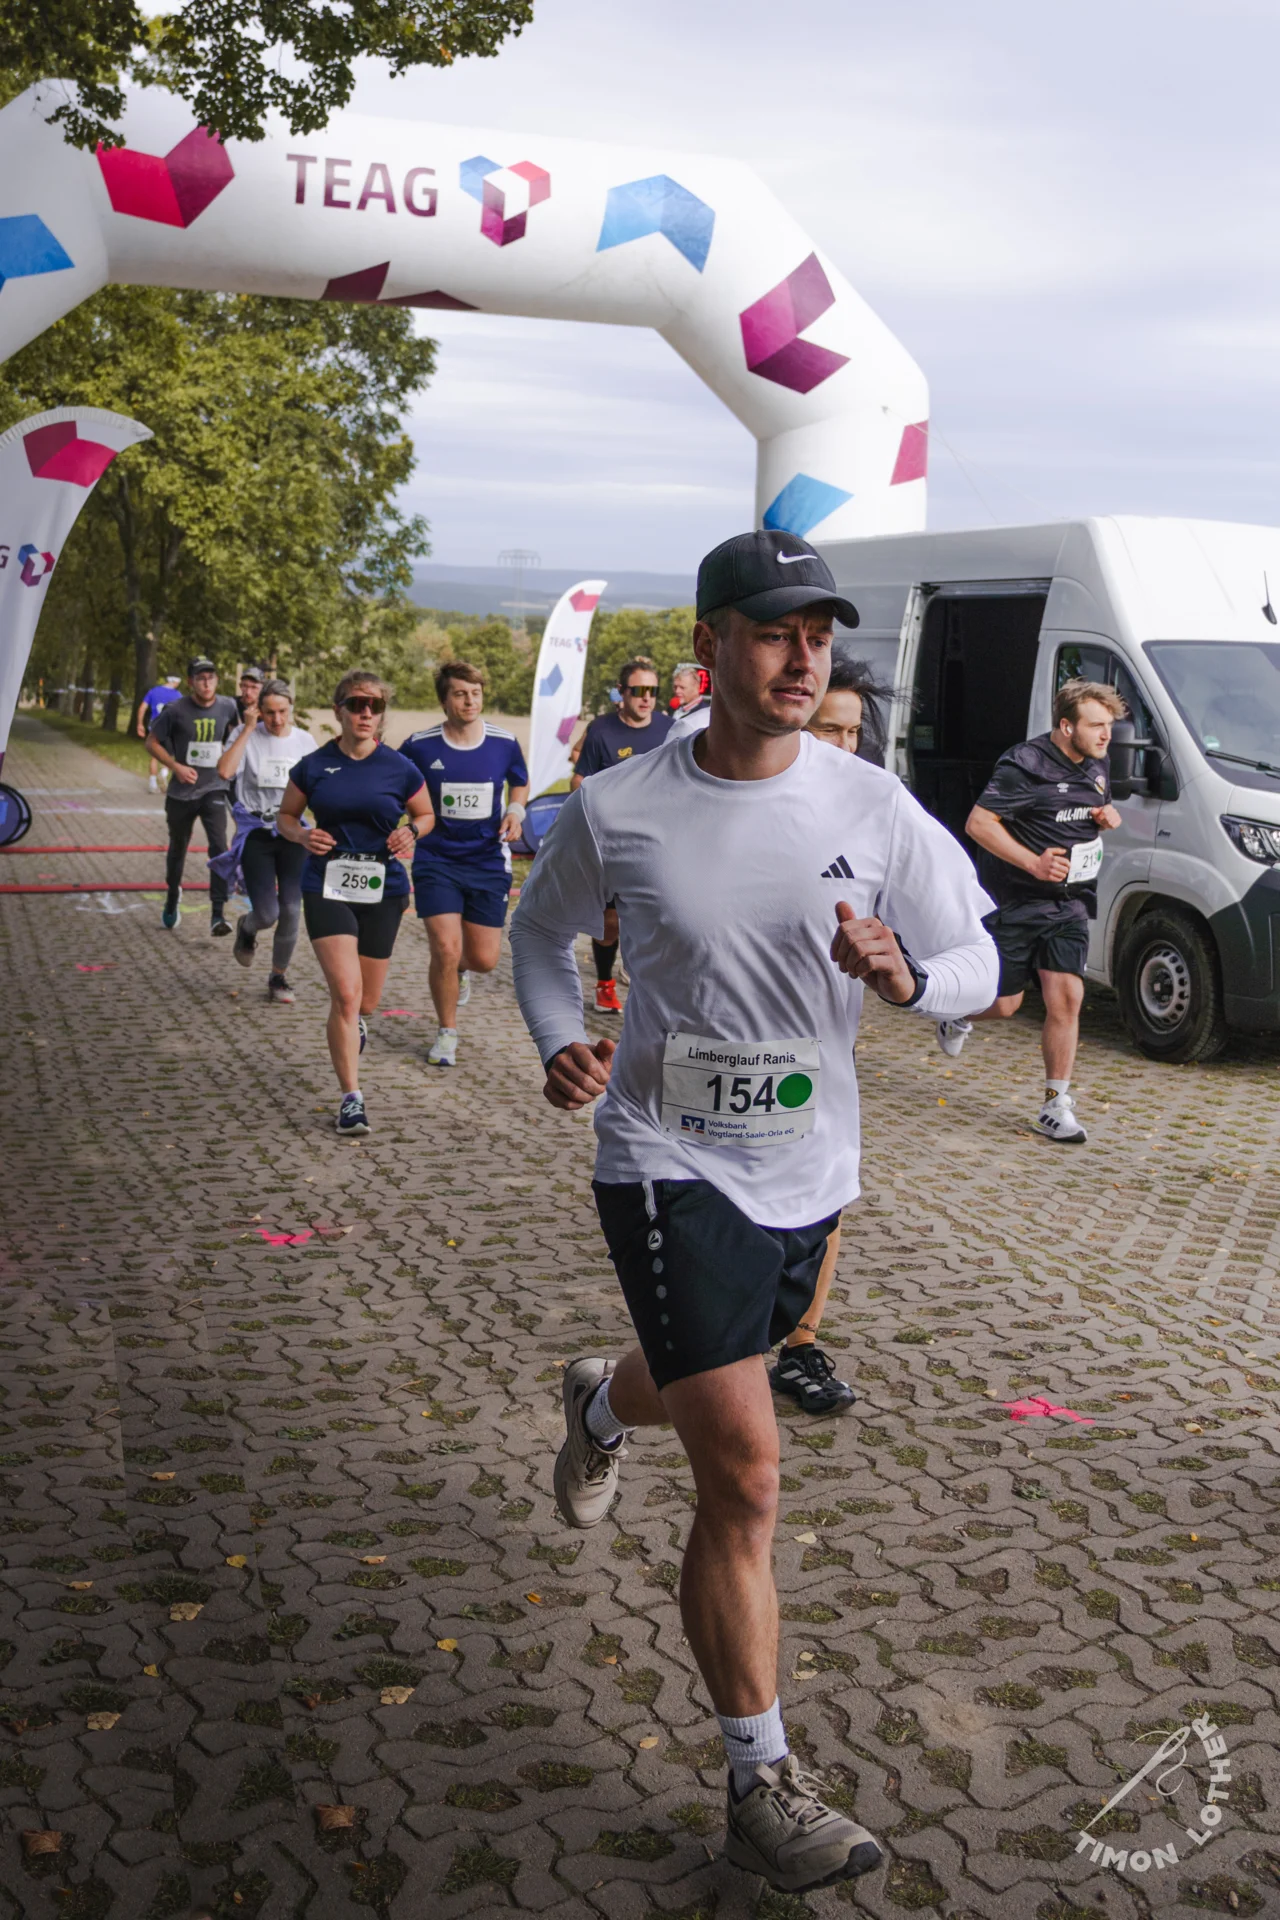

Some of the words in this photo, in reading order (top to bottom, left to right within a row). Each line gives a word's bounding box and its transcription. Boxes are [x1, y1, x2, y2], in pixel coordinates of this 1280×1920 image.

[286, 153, 439, 217] TEAG
[549, 637, 573, 649] TEAG
[456, 795, 479, 808] 152
[341, 873, 369, 889] 259
[687, 1046, 760, 1068] Limberglauf
[763, 1051, 796, 1065] Ranis
[707, 1074, 776, 1114] 154
[708, 1120, 748, 1130] Volksbank
[708, 1128, 783, 1139] Vogtland-Saale-Orla
